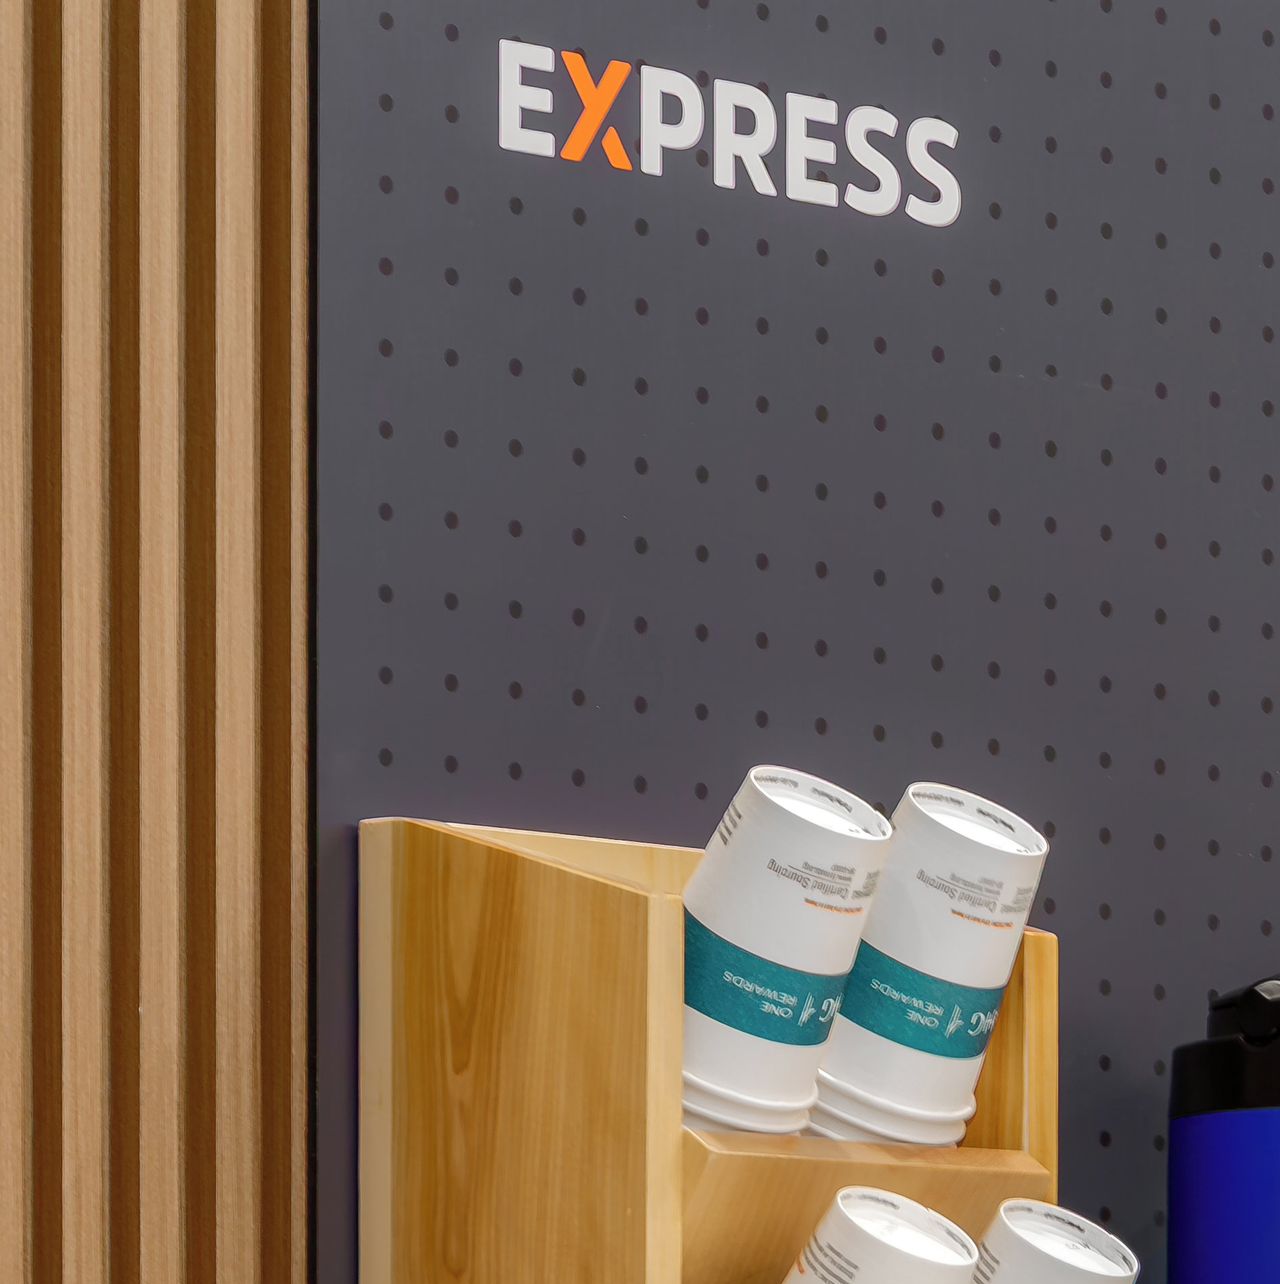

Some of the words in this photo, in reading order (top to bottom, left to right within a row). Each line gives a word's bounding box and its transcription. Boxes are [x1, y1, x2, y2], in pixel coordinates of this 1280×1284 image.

[498, 37, 963, 229] EXPRESS
[722, 969, 799, 1008] REWARDS
[870, 978, 945, 1017] REWARDS
[760, 1000, 794, 1019] ONE
[903, 1008, 941, 1030] ONE
